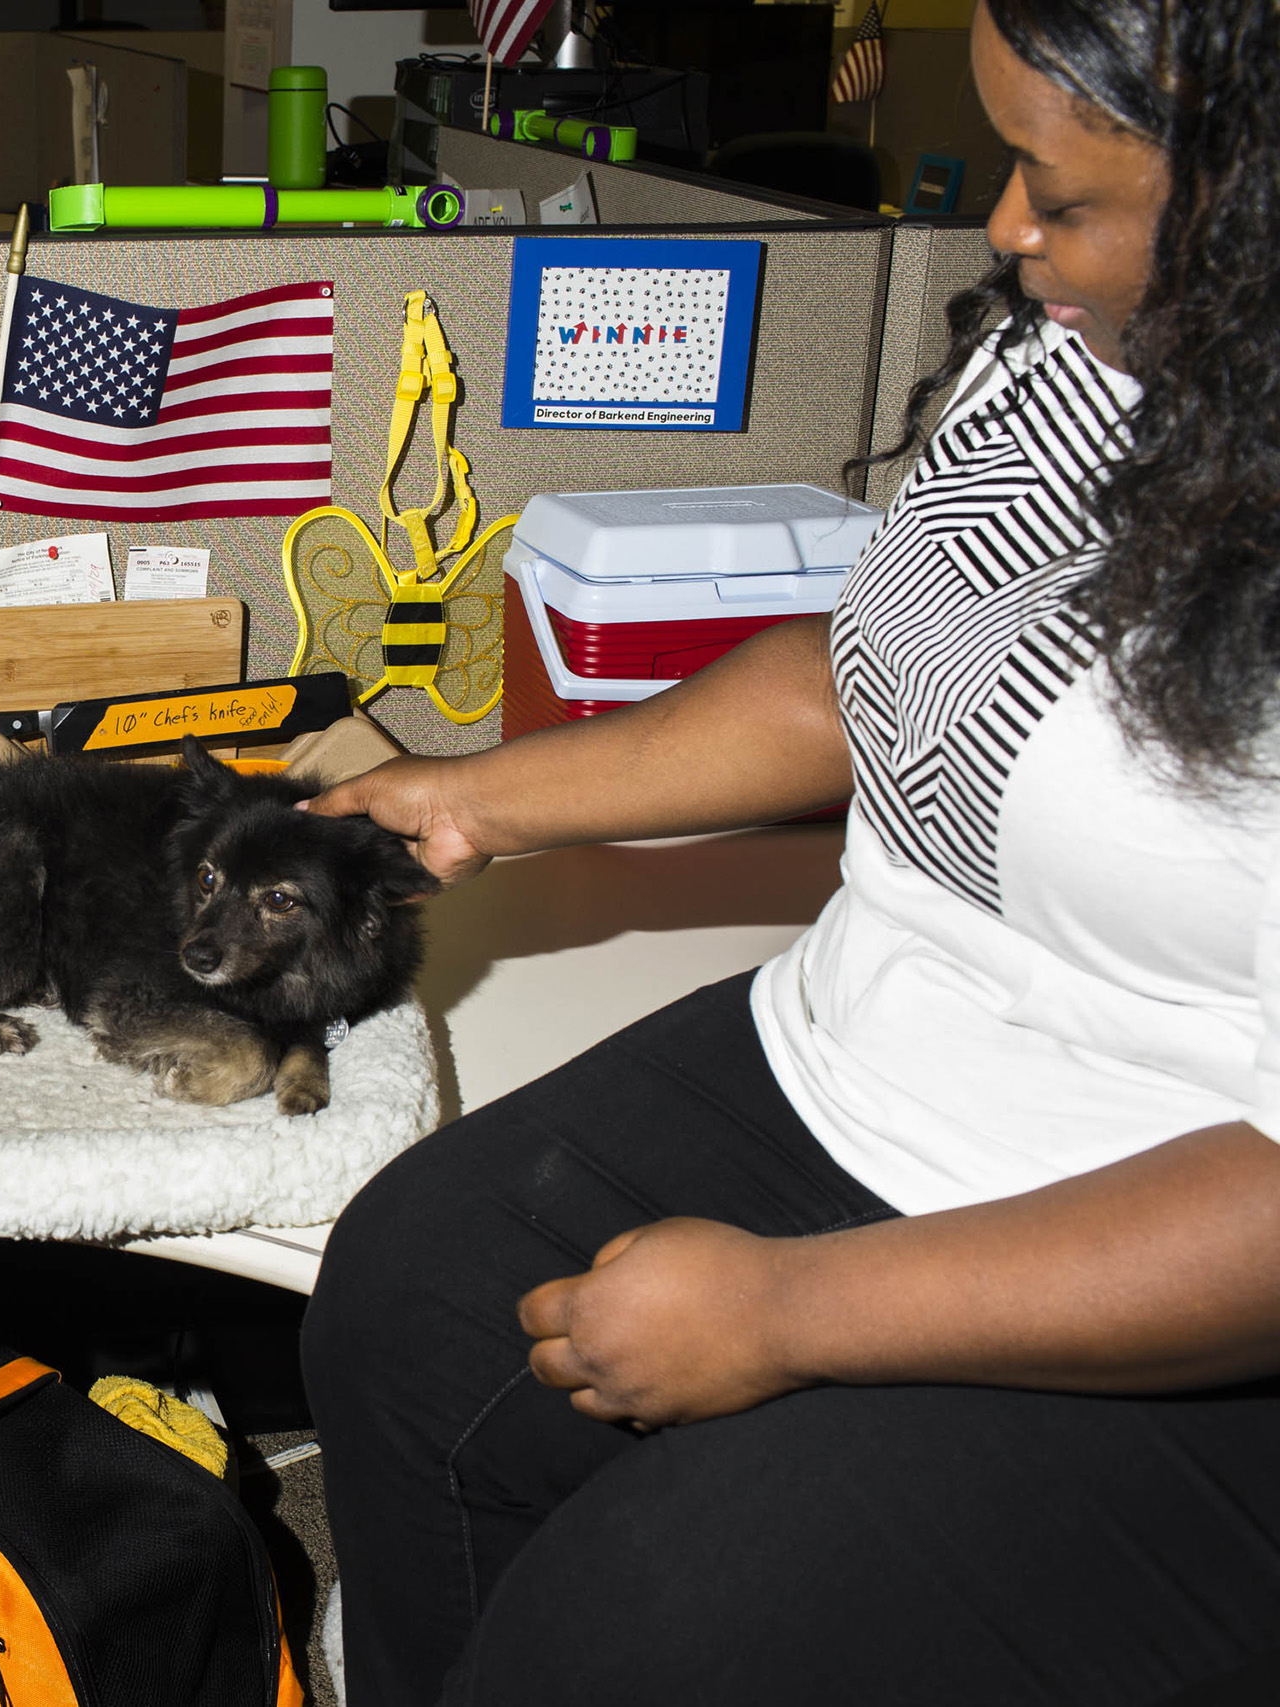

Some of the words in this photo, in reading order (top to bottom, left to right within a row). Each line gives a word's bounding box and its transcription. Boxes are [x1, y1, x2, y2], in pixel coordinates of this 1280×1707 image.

[558, 322, 687, 345] WINNIE
[536, 408, 584, 420] Director
[585, 409, 598, 420] of
[598, 410, 646, 421] Barkend
[646, 411, 712, 423] Engineering
[154, 705, 200, 727] Chef's
[209, 700, 246, 721] knife
